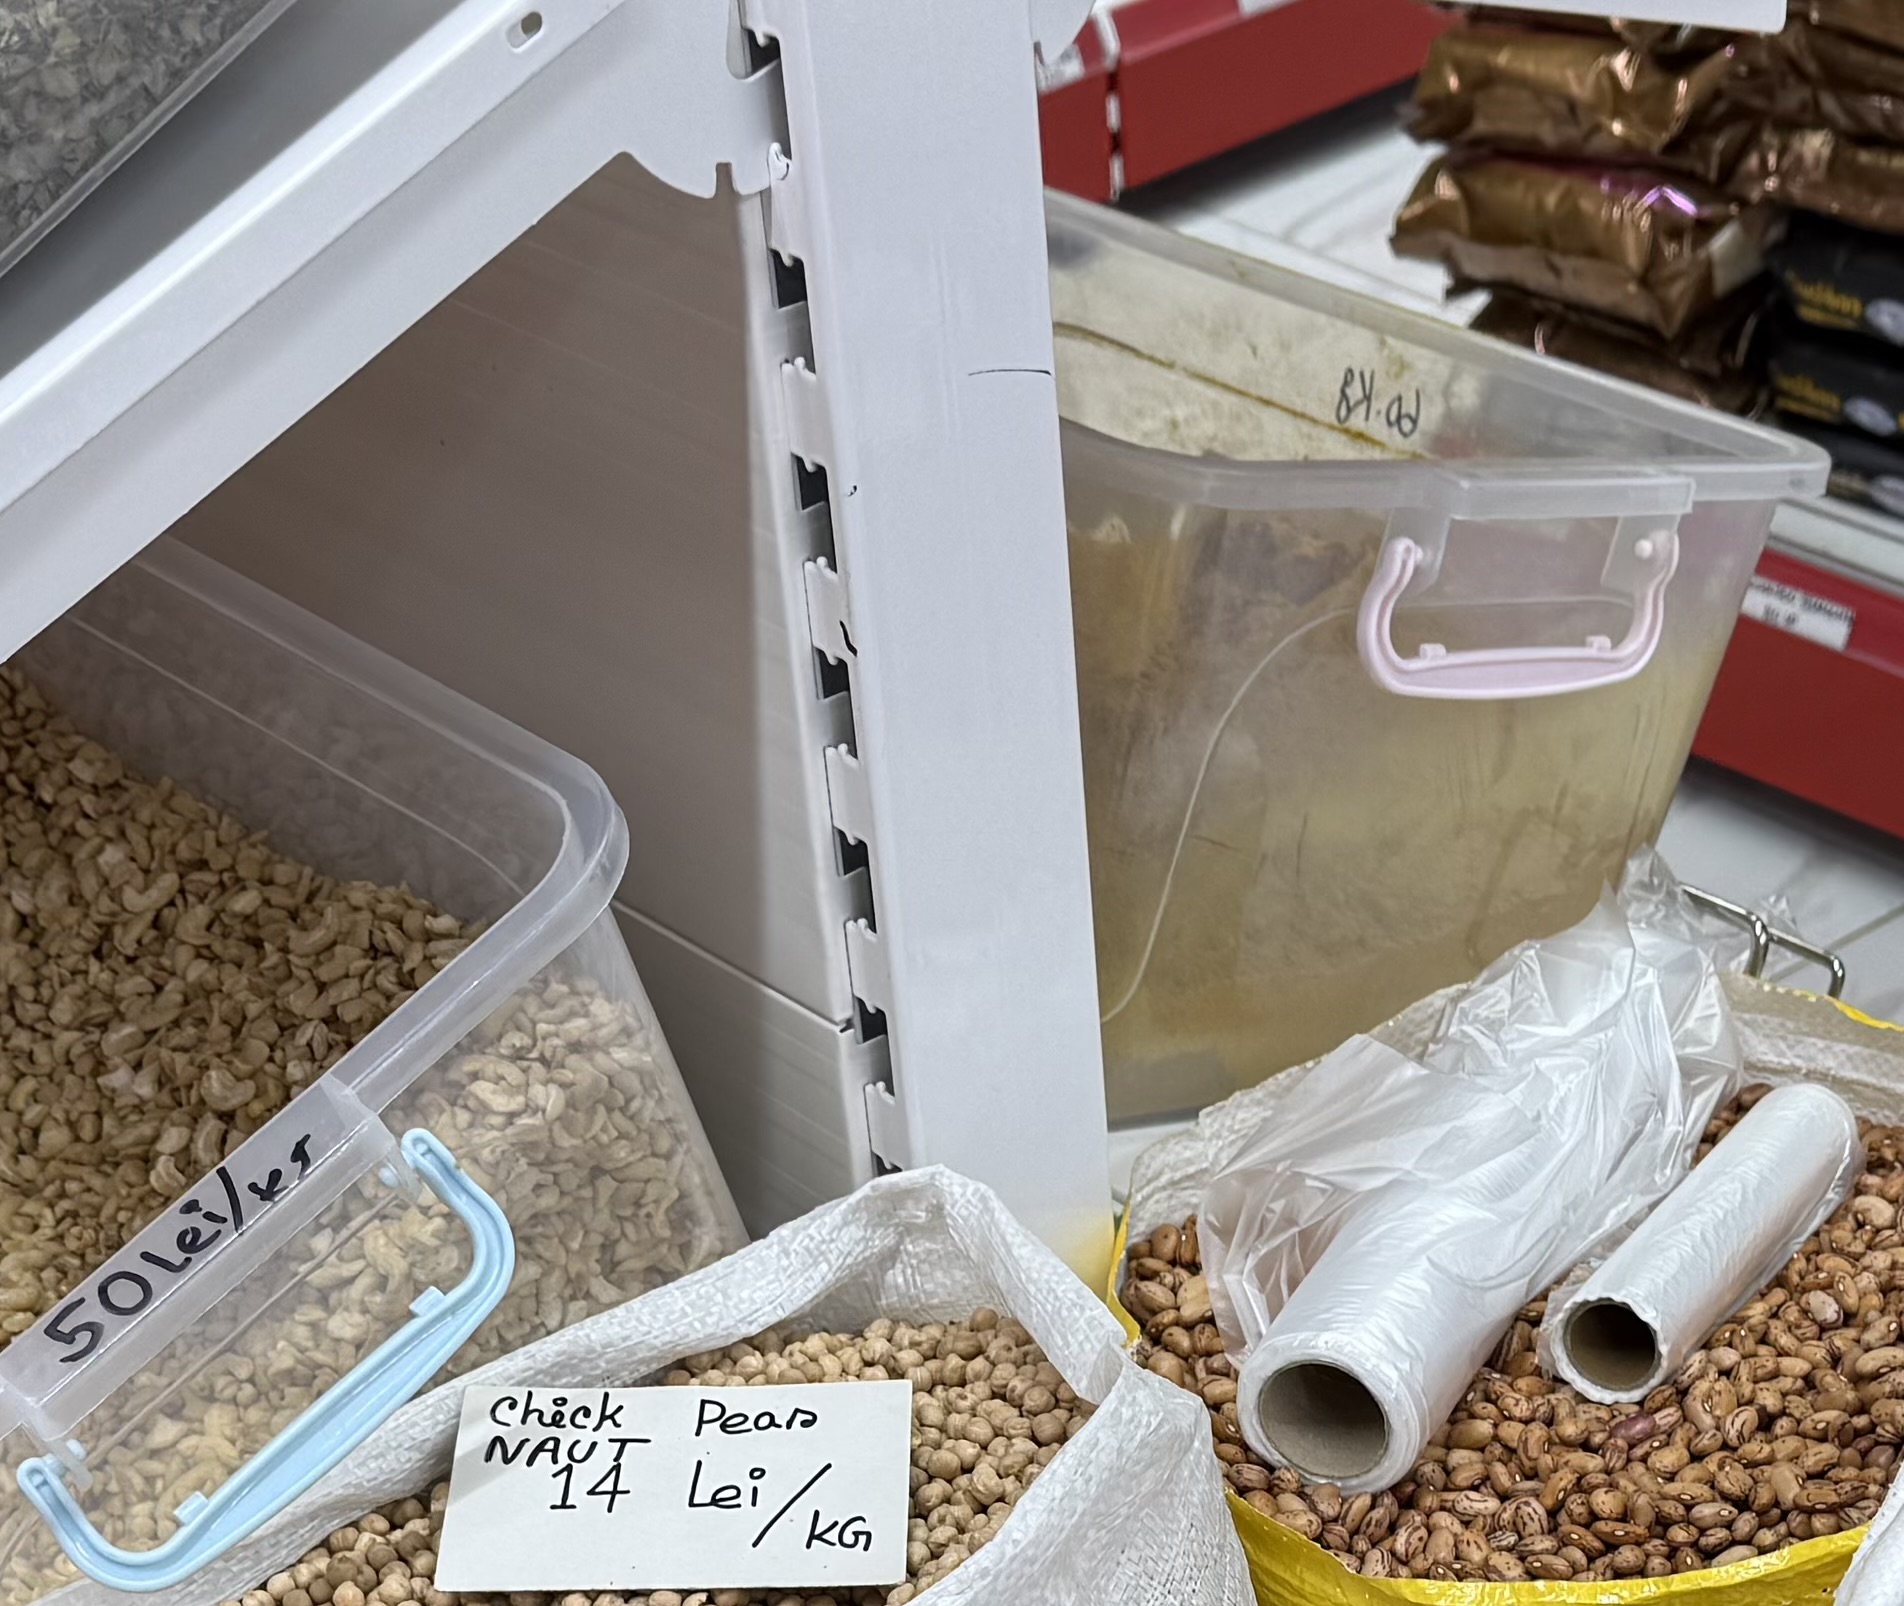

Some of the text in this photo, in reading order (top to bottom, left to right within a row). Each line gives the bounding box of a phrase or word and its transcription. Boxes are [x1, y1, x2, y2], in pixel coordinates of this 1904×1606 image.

[488, 1391, 624, 1433] Chick
[483, 1436, 652, 1468] NAUT
[549, 1463, 631, 1514] 14
